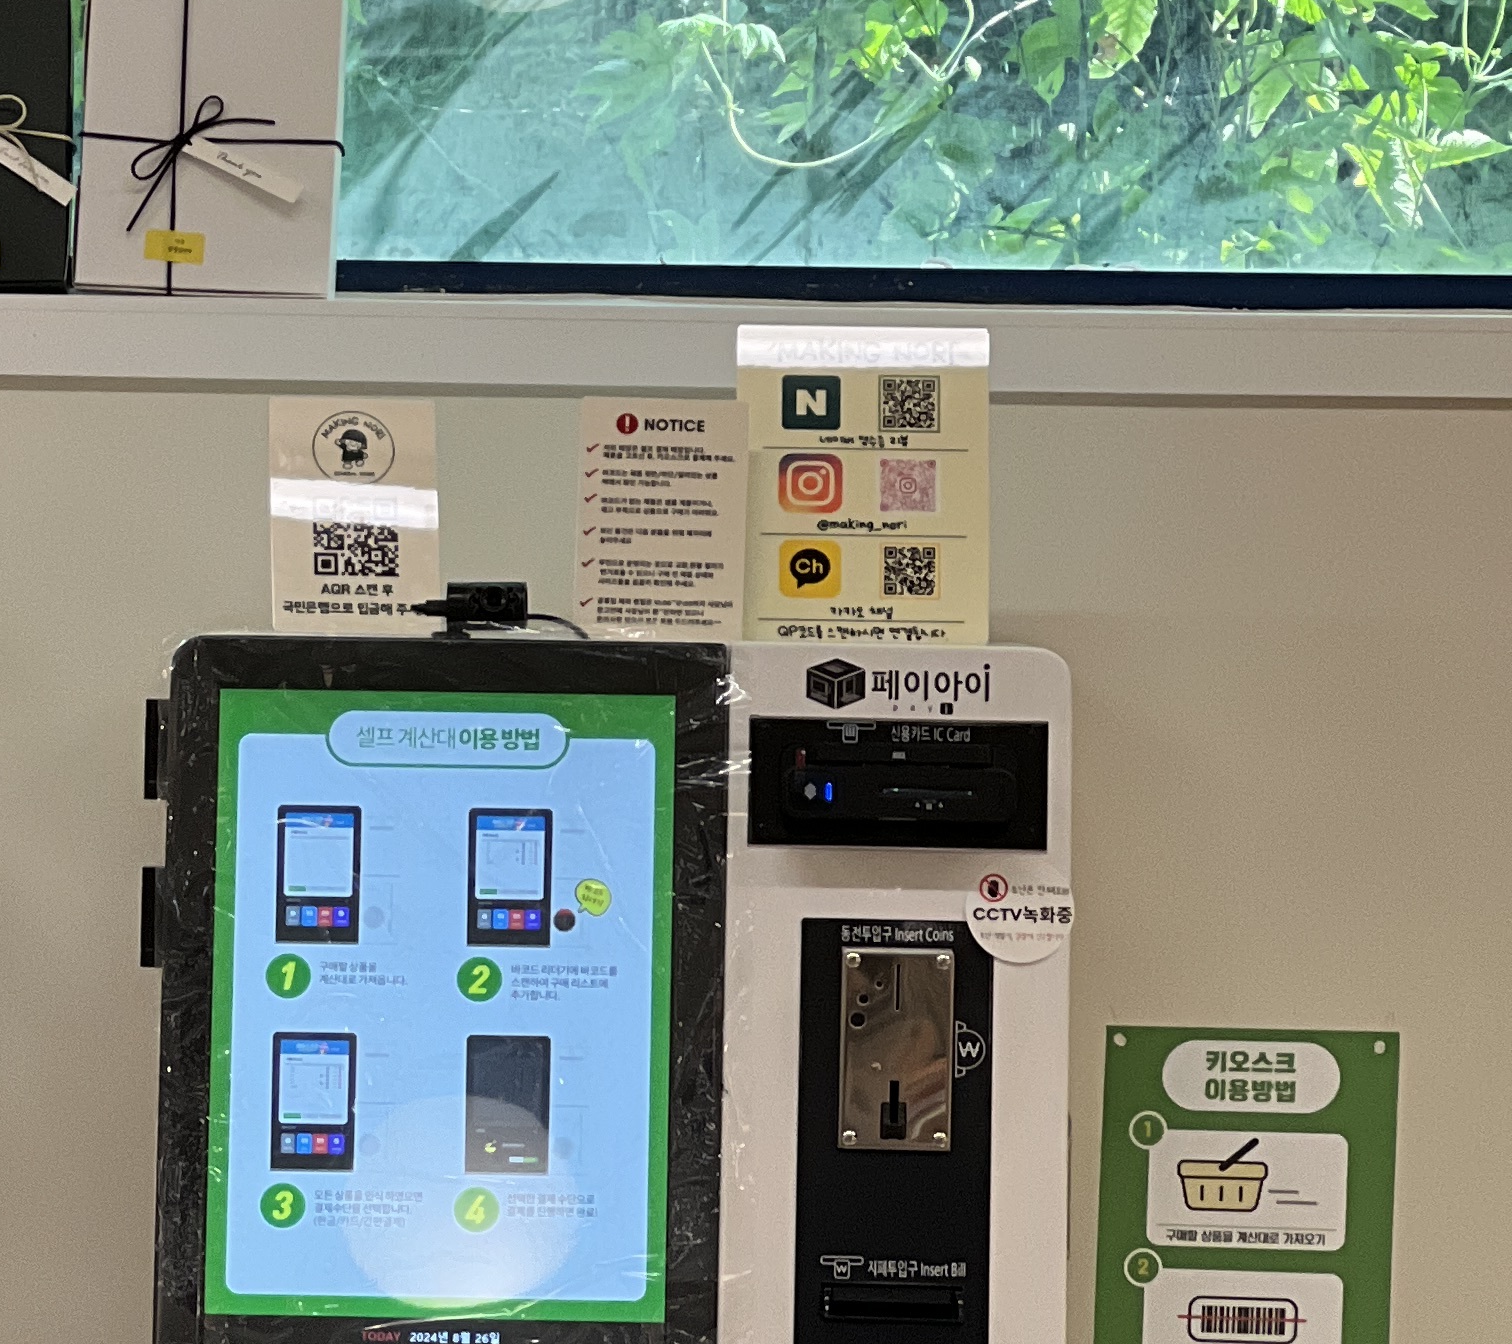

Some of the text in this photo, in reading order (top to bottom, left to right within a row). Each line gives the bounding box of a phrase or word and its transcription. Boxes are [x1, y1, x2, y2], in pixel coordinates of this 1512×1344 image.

[795, 388, 828, 416] N
[644, 418, 705, 433] NOTICE
[816, 518, 907, 532] @making_nori
[795, 558, 824, 575] Ch
[830, 606, 865, 618] 카카오
[871, 663, 991, 702] 페이아이
[891, 725, 971, 743] 신용카드 IC Card
[973, 905, 1073, 924] CCTV녹화중
[841, 924, 954, 943] 동전투입구 Insert Coins
[281, 961, 297, 991] 1
[468, 964, 491, 995] 2
[1205, 1050, 1297, 1074] 키오스크
[1204, 1078, 1297, 1103] 이용방법
[272, 1190, 294, 1221] 3
[464, 1194, 486, 1225] 4
[1166, 1228, 1198, 1242] 구매할
[1201, 1230, 1233, 1243] 상품을
[1237, 1231, 1280, 1244] 계산대로
[868, 1260, 967, 1278] 지폐투입구 Insert Bill
[361, 1331, 401, 1342] TODAY
[409, 1331, 449, 1344] 2024년
[452, 1331, 471, 1344] 8월
